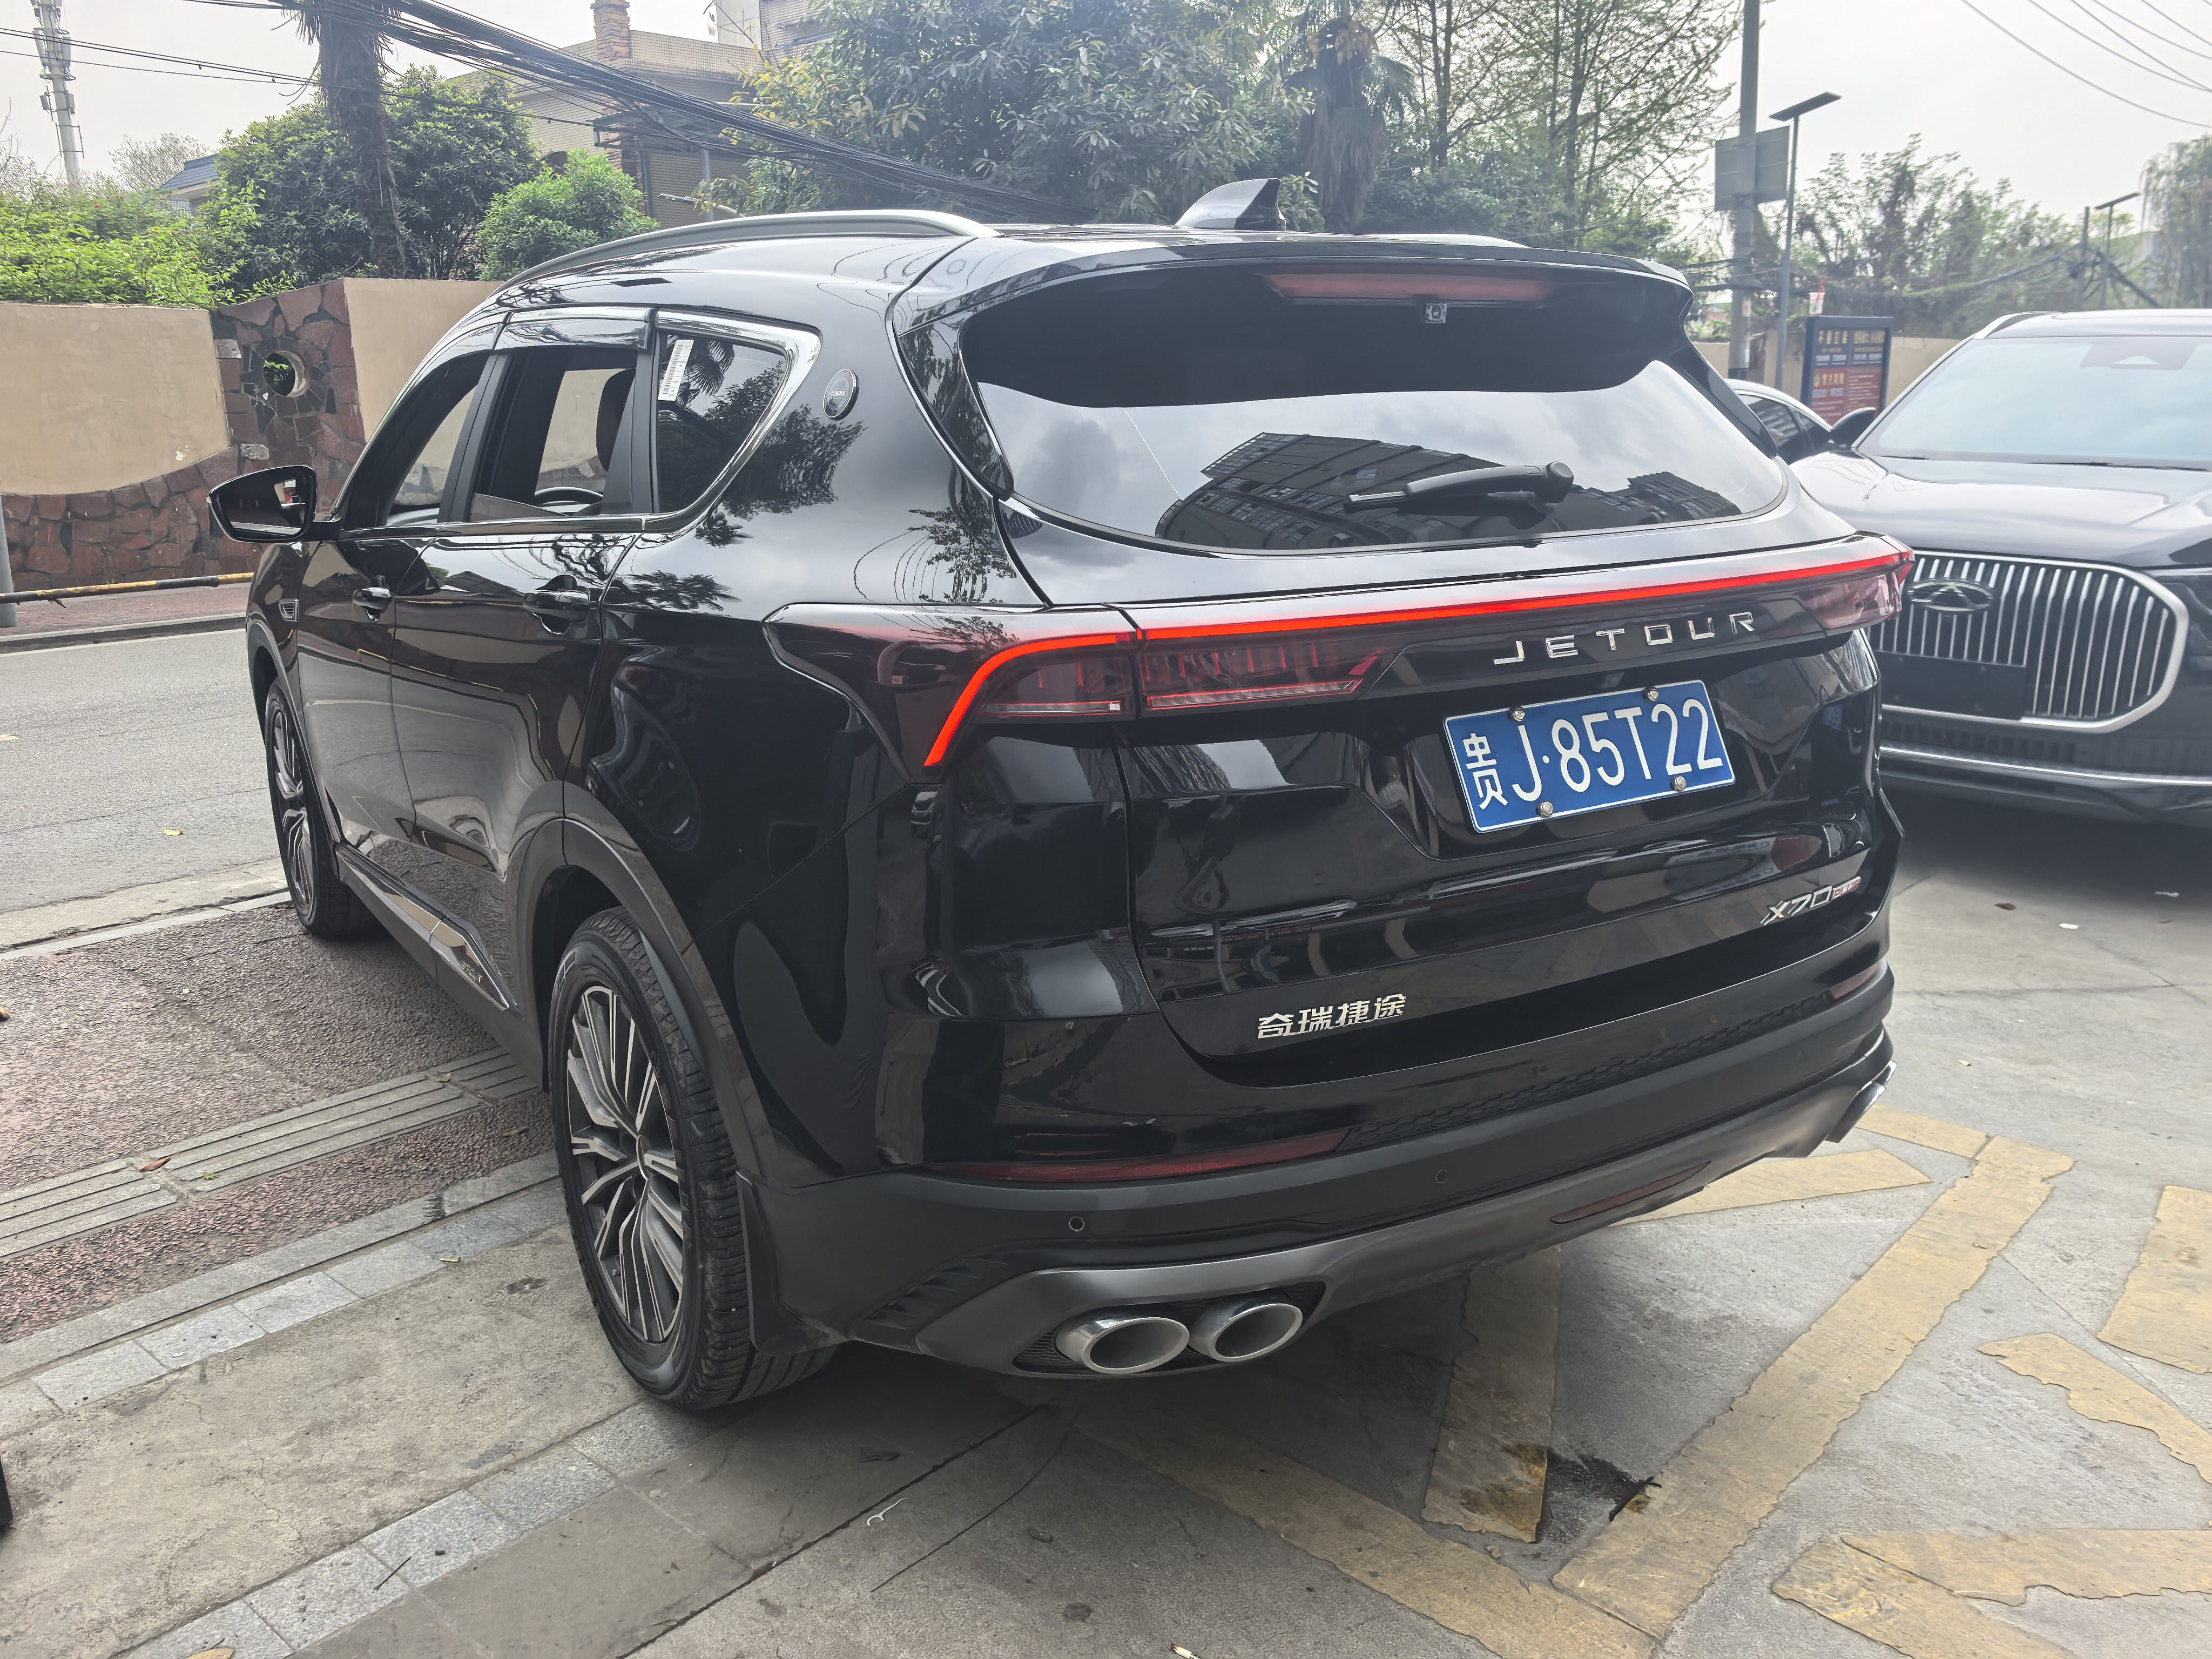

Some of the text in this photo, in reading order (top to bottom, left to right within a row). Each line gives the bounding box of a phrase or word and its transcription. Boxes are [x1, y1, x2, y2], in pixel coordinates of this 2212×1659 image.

[1493, 611, 1755, 666] JETOUR
[1257, 993, 1406, 1039] 奇瑞捷途
